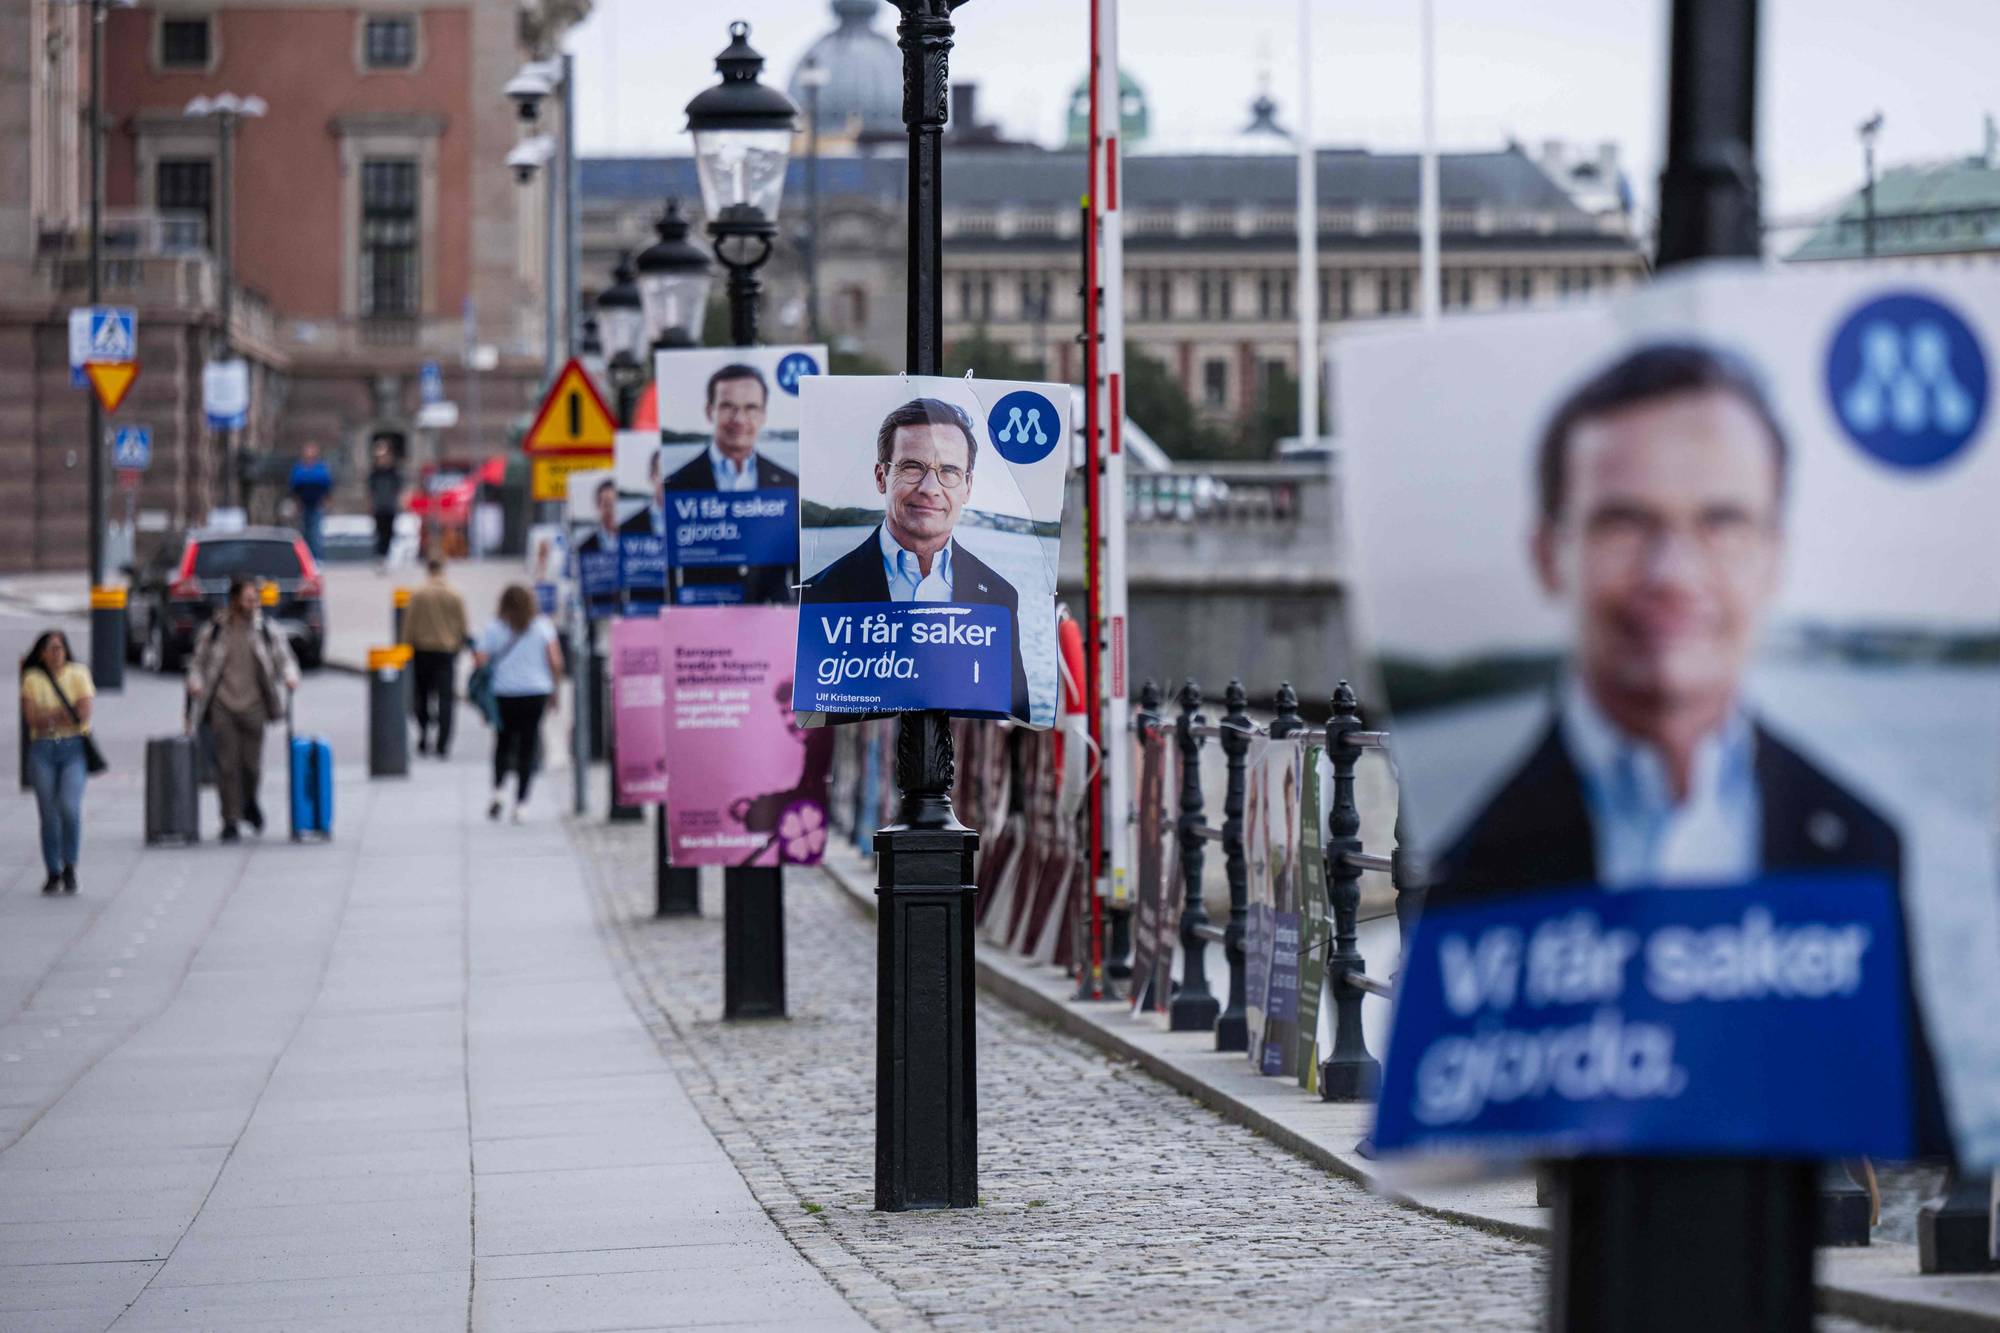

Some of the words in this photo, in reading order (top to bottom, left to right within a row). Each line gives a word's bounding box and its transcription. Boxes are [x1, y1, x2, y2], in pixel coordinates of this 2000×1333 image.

[675, 498, 698, 519] Vi
[701, 496, 729, 519] får
[731, 496, 788, 518] saker
[821, 616, 851, 644] Vi
[860, 614, 903, 644] får
[911, 616, 996, 646] saker
[817, 651, 919, 685] gjorda.
[816, 693, 829, 701] Ulf
[831, 694, 881, 702] Kristersson
[816, 704, 870, 713] Statsminister
[1439, 927, 1523, 1017] Vi
[1525, 910, 1636, 1008] får
[1644, 906, 1871, 1003] saker
[1410, 1008, 1688, 1127] gjorda.
